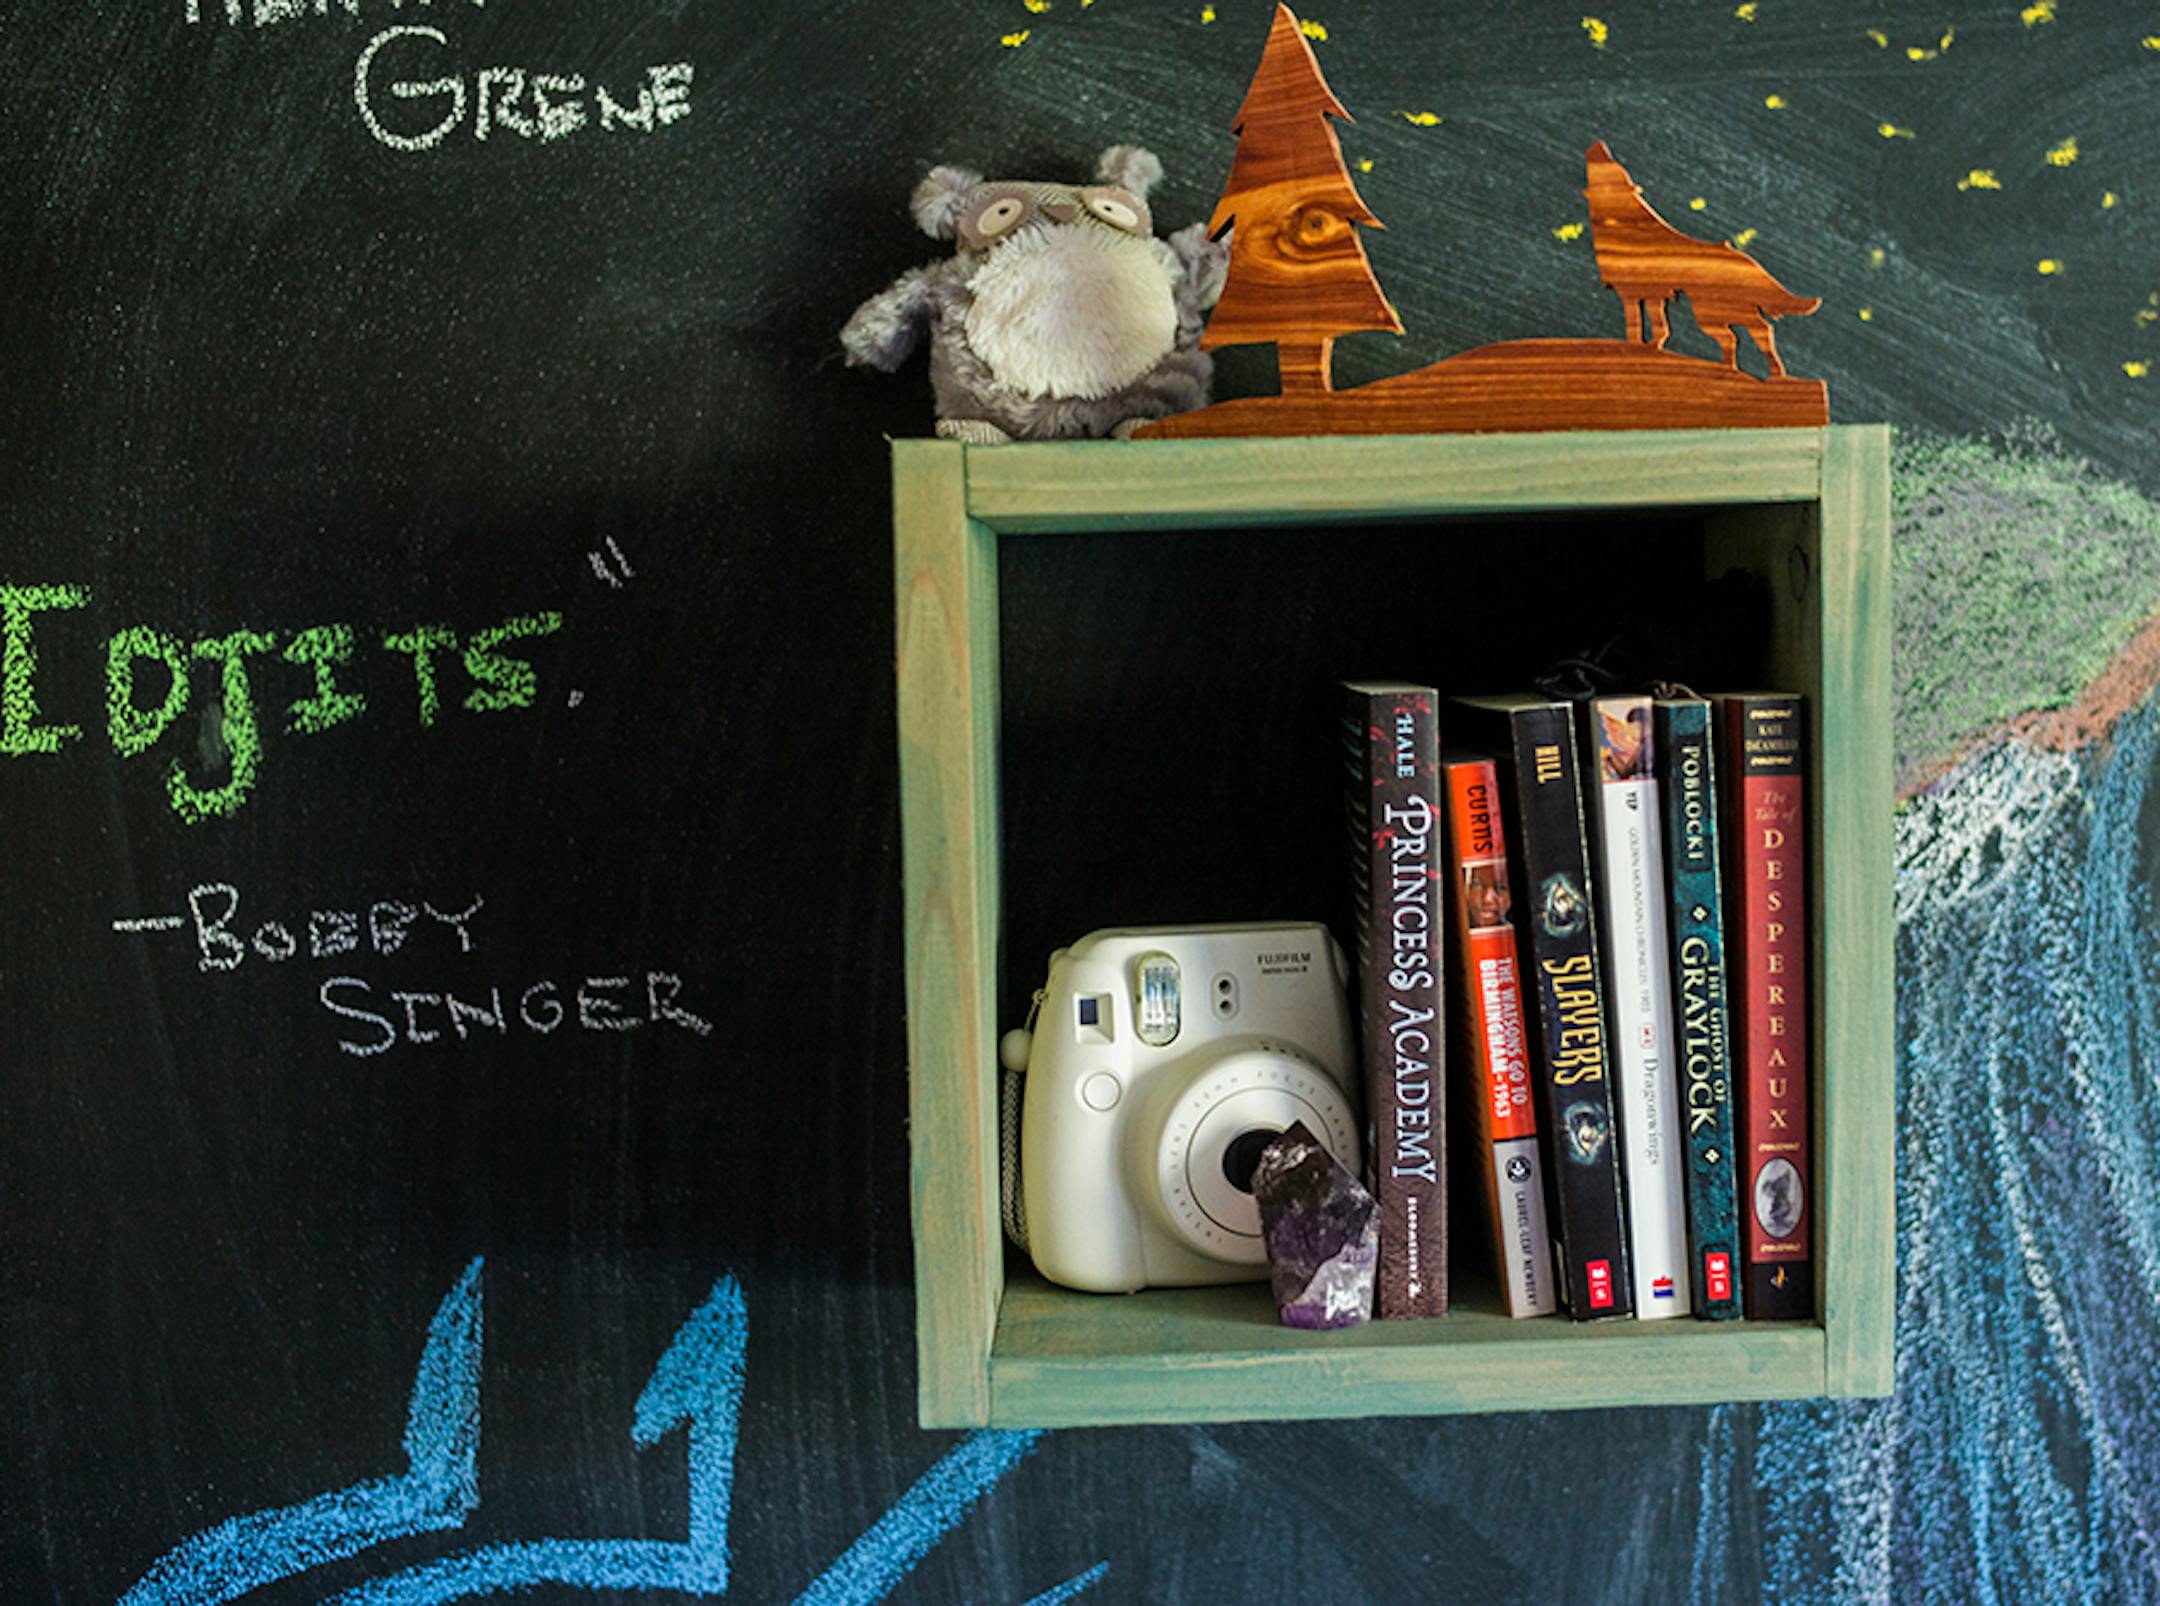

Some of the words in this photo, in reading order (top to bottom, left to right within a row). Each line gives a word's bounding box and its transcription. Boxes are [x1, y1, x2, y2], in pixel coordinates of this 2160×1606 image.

[354, 24, 695, 152] GRENE
[1396, 712, 1415, 779] HALE
[1534, 742, 1562, 785] HILL
[1467, 785, 1493, 853] CURTIS
[1680, 744, 1705, 860] POBLOCKI
[1384, 795, 1434, 991] PRINCESS
[1257, 953, 1311, 965] FUJIFILM
[1498, 956, 1514, 984] THE
[1764, 827, 1788, 1130] DESPEREAUX
[320, 971, 712, 1057] SINGER
[1502, 987, 1522, 1057] WATSONS
[1541, 953, 1603, 1087] SLAYERS
[1681, 936, 1717, 1133] GRAYLOCK
[1710, 1007, 1723, 1071] GHOST
[1388, 999, 1437, 1183] ACADEMY
[1508, 1060, 1525, 1082] GO
[1511, 1085, 1527, 1105] TO
[1643, 1057, 1663, 1166] Dragonwings
